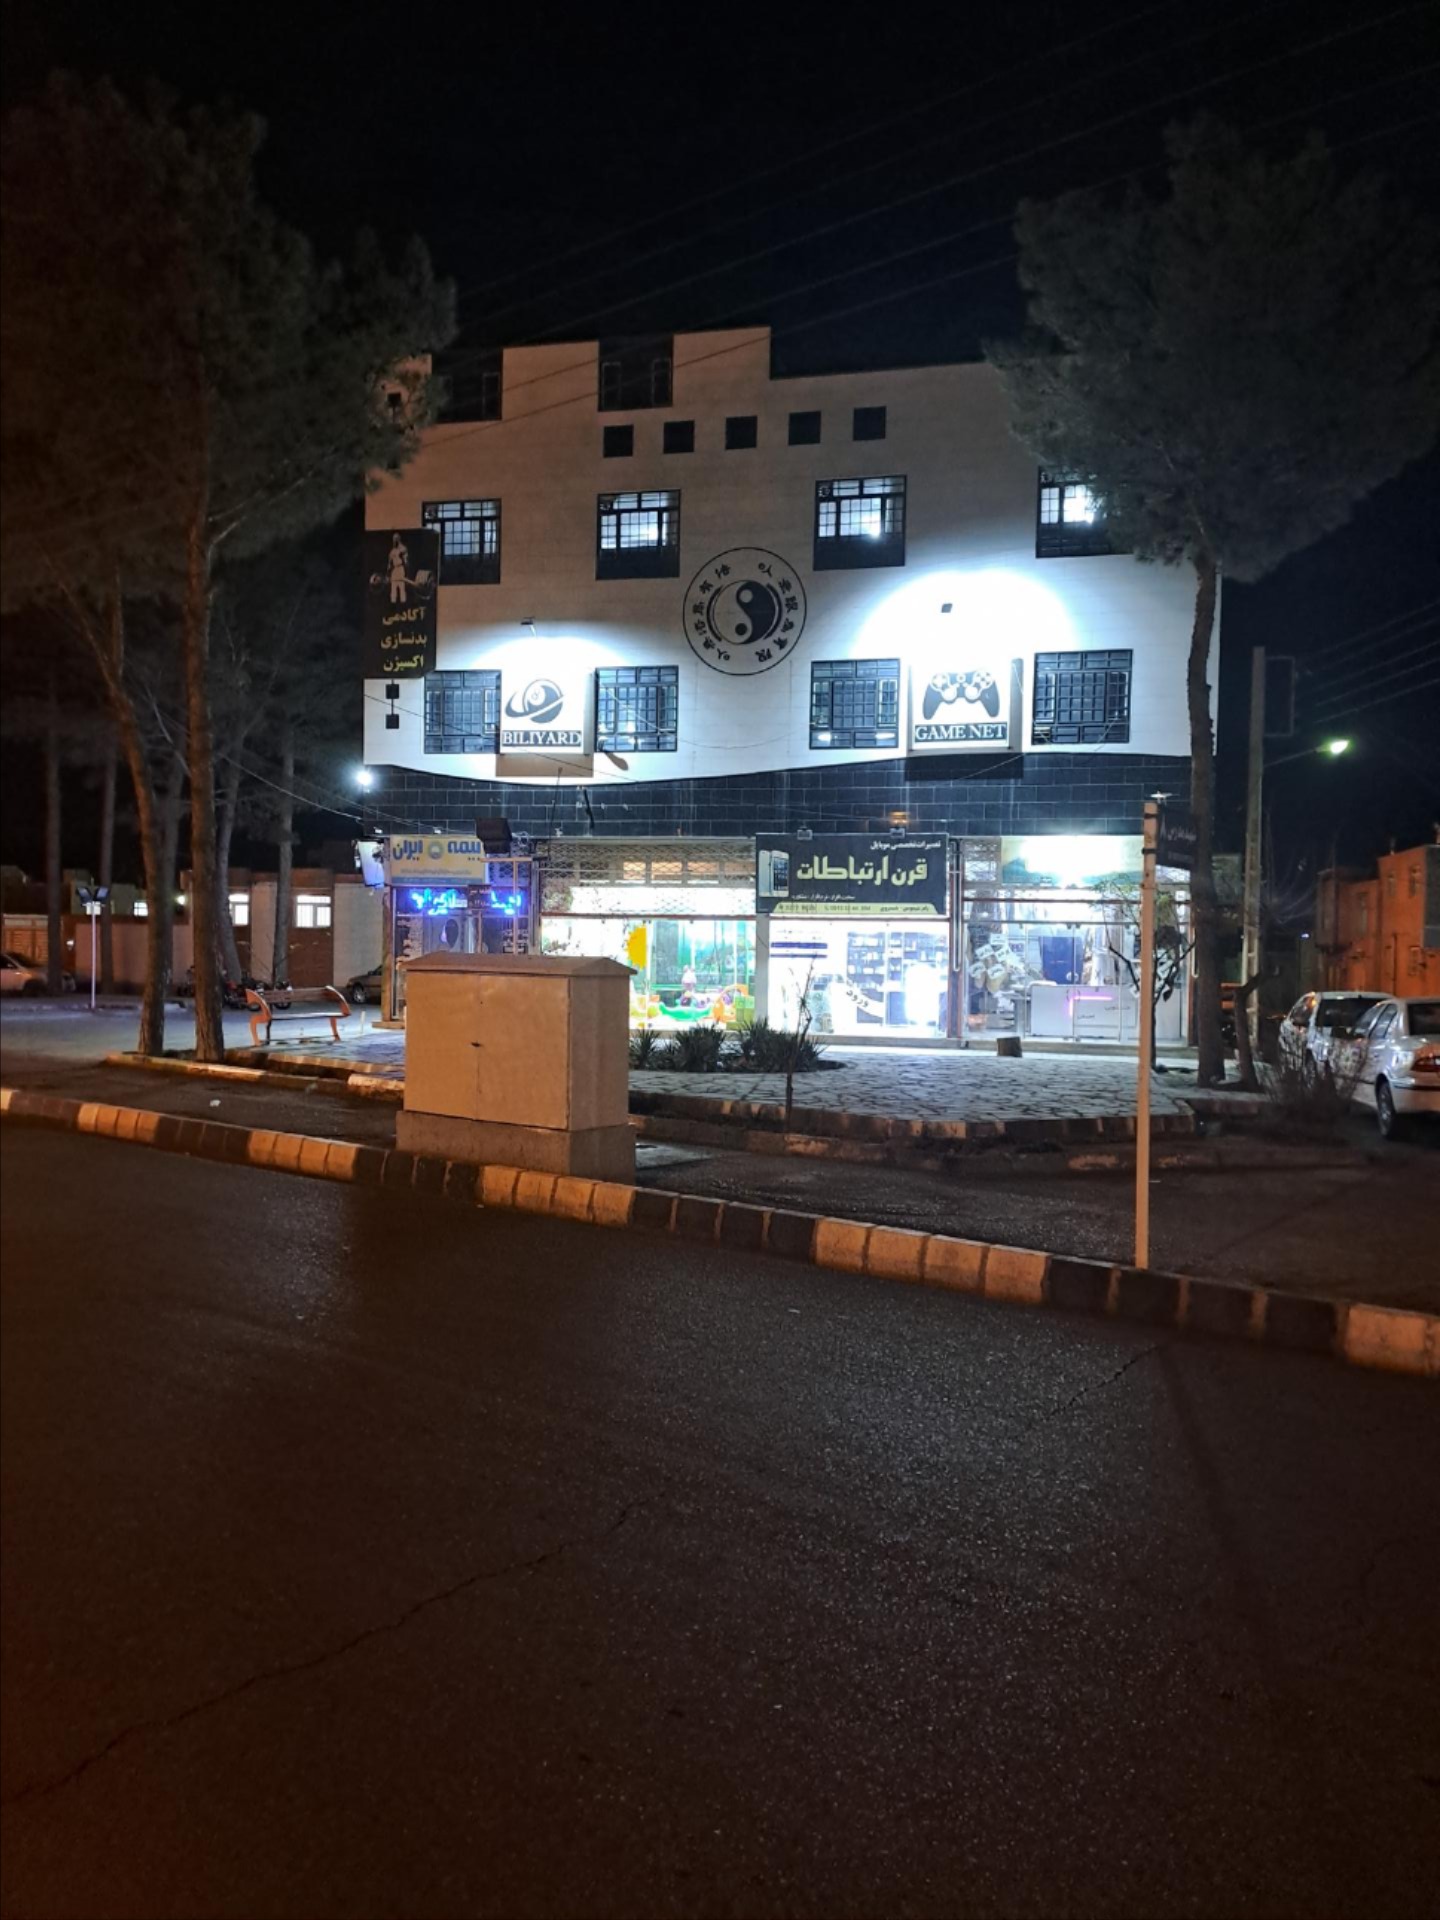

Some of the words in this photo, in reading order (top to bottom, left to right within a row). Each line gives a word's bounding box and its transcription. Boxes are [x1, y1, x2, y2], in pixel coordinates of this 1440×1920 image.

[382, 606, 426, 625] آکادمی
[380, 632, 427, 649] بدنسازی
[383, 654, 424, 672] اکسیژن
[503, 731, 582, 745] BILIYARD
[915, 725, 966, 740] GAME
[968, 724, 1006, 738] NET
[392, 839, 424, 861] ایران
[447, 841, 481, 861] بیمه
[870, 840, 890, 851] موبایل
[890, 840, 917, 850] تخصصی
[917, 840, 941, 850] تعمیرات
[796, 855, 889, 886] ارتباطات
[891, 858, 928, 886] قرن
